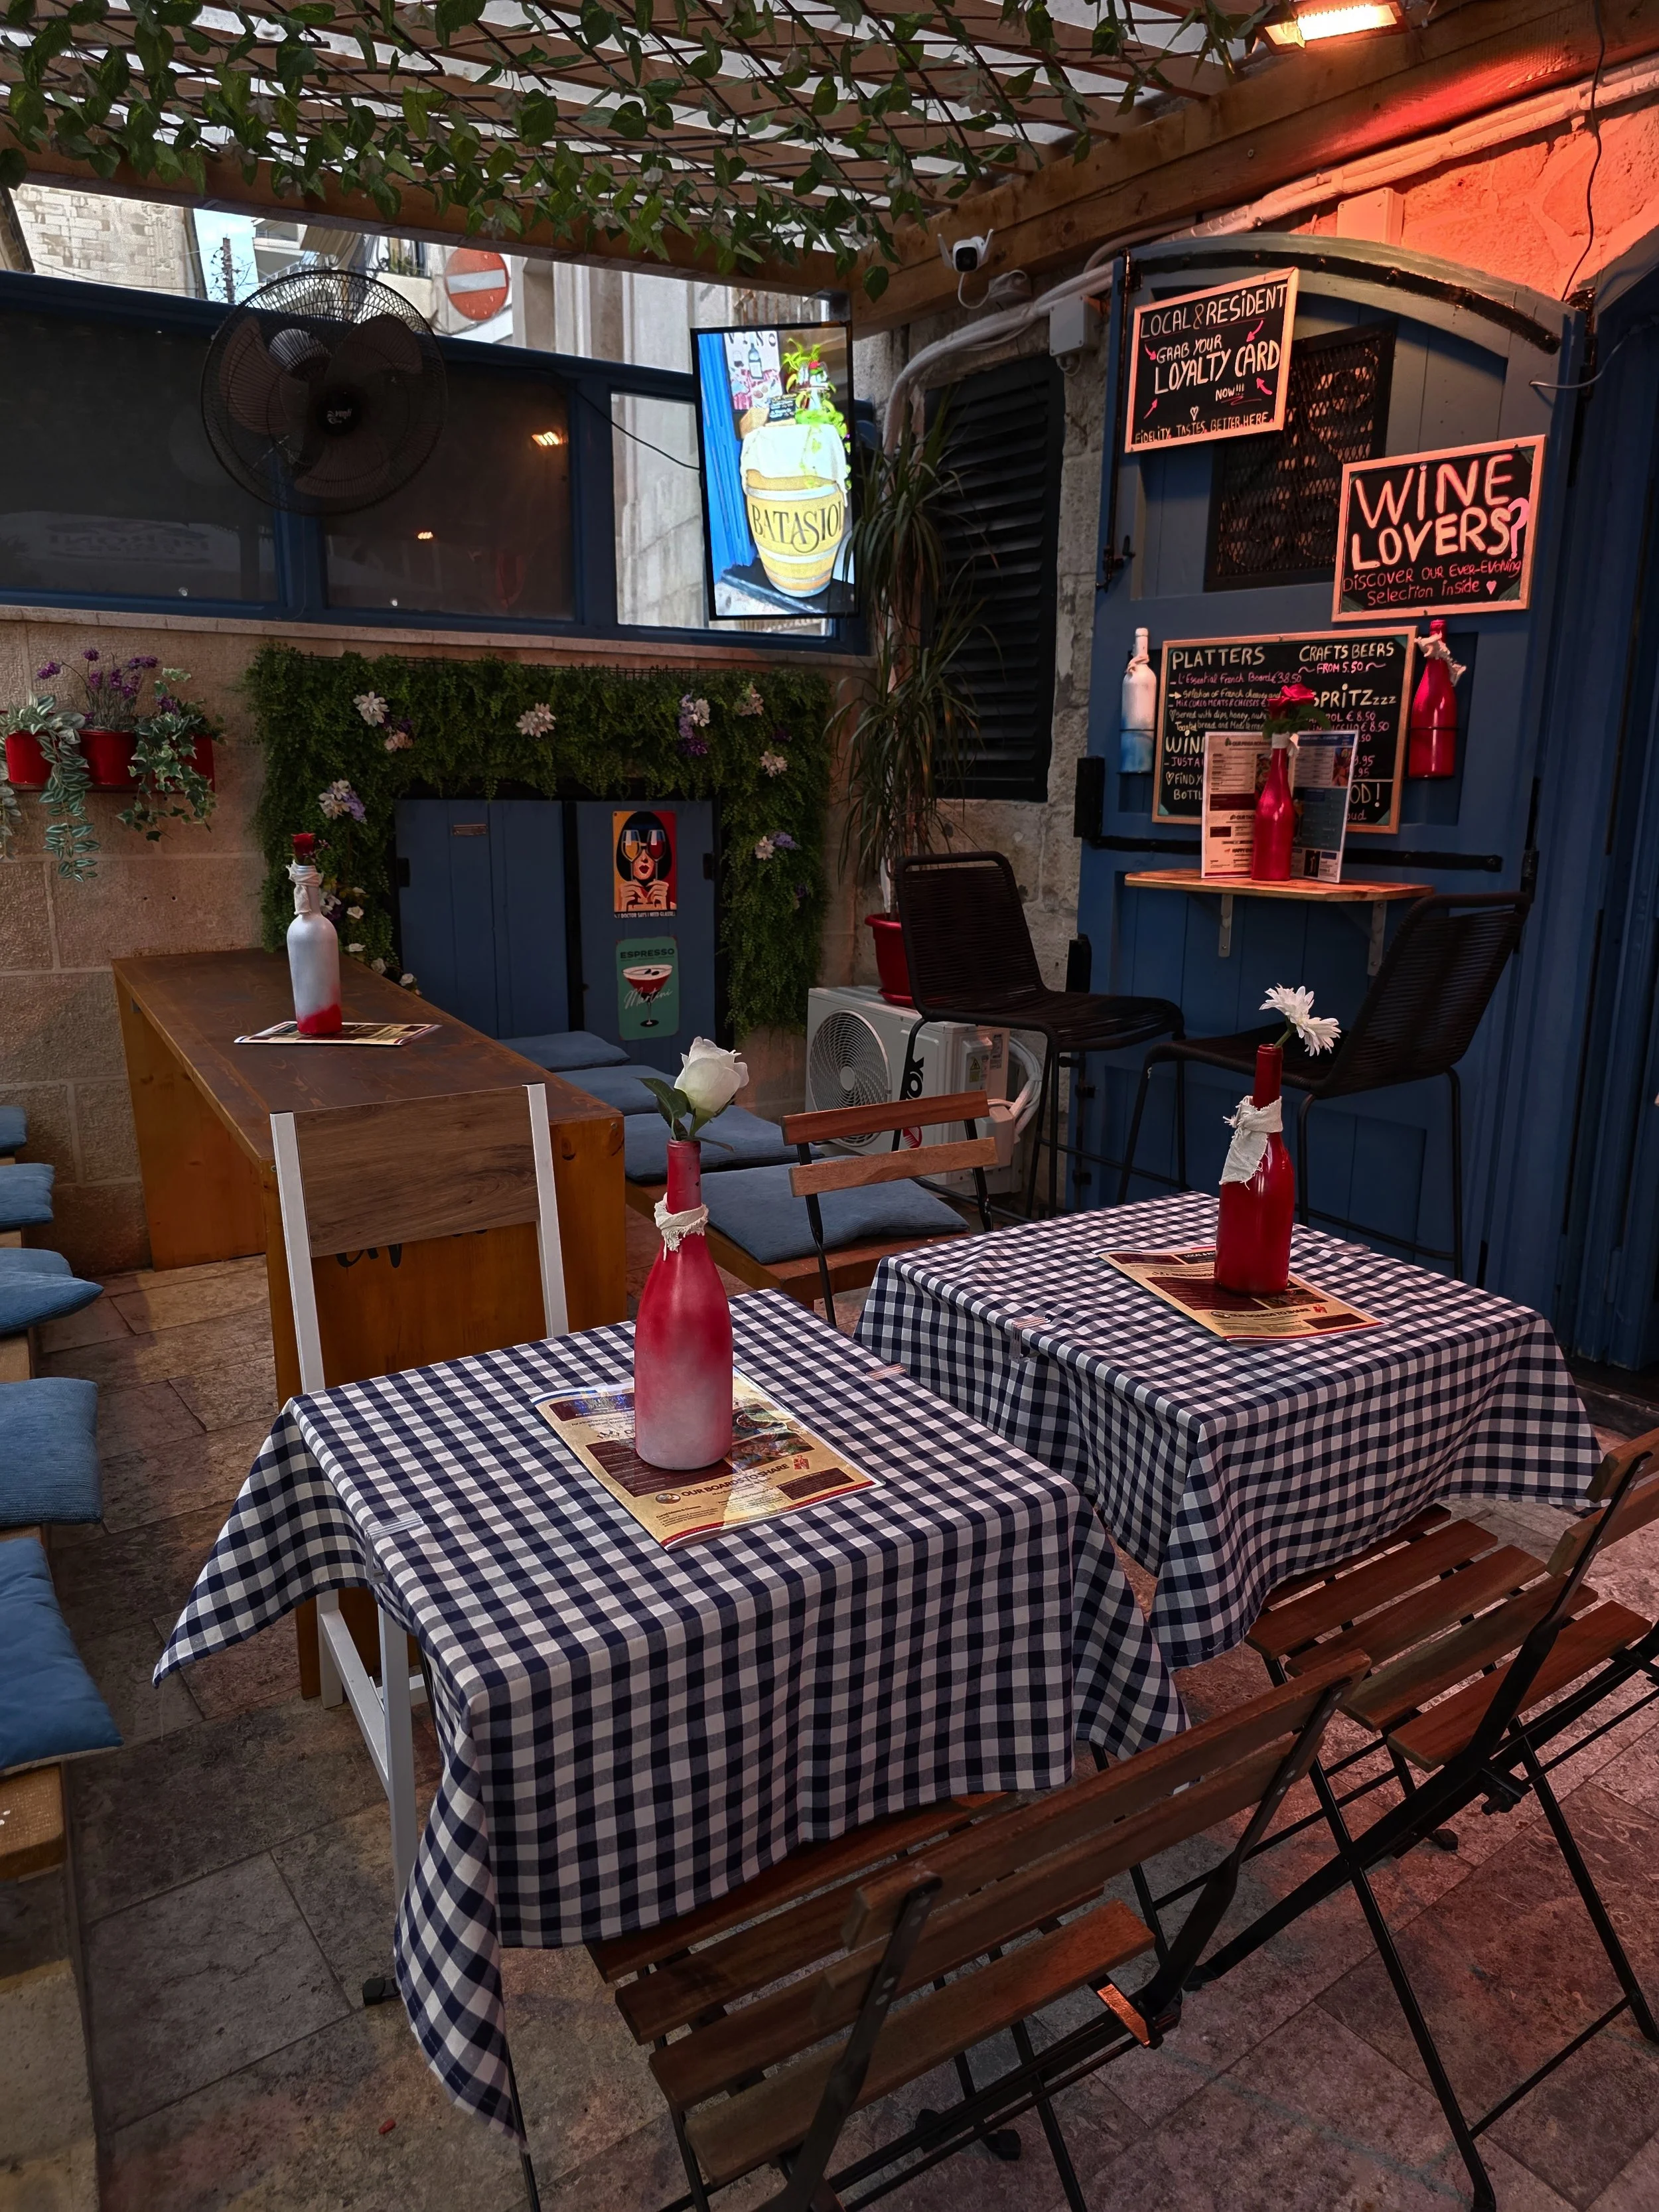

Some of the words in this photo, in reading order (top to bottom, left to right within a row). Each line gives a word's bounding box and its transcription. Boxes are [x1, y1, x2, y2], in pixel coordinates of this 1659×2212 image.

[1140, 307, 1192, 339] LOCAL
[1156, 342, 1190, 364] GRAB
[1193, 334, 1222, 356] YOUR
[1155, 348, 1232, 395] LOYALTY
[1234, 339, 1281, 378] CARD
[1215, 383, 1244, 402] NOW!!!
[1421, 566, 1444, 581] OUR
[1172, 646, 1266, 671] PLATTERS
[1299, 644, 1350, 662] CRAFTS
[1351, 641, 1395, 660] BEERS
[1317, 663, 1340, 674] FROM
[1342, 660, 1364, 674] 5.50
[1220, 672, 1245, 684] French
[1220, 688, 1244, 698] French
[1208, 699, 1228, 707] MEATS
[1197, 708, 1212, 718] with
[1197, 720, 1216, 729] bread
[1171, 757, 1193, 767] JUST
[620, 948, 675, 959] ESPRESSO
[624, 986, 674, 1010] Martini
[681, 1488, 703, 1497] OUR
[703, 1476, 746, 1493] BOARDS
[743, 1473, 758, 1483] TO
[757, 1463, 790, 1477] SHARE
